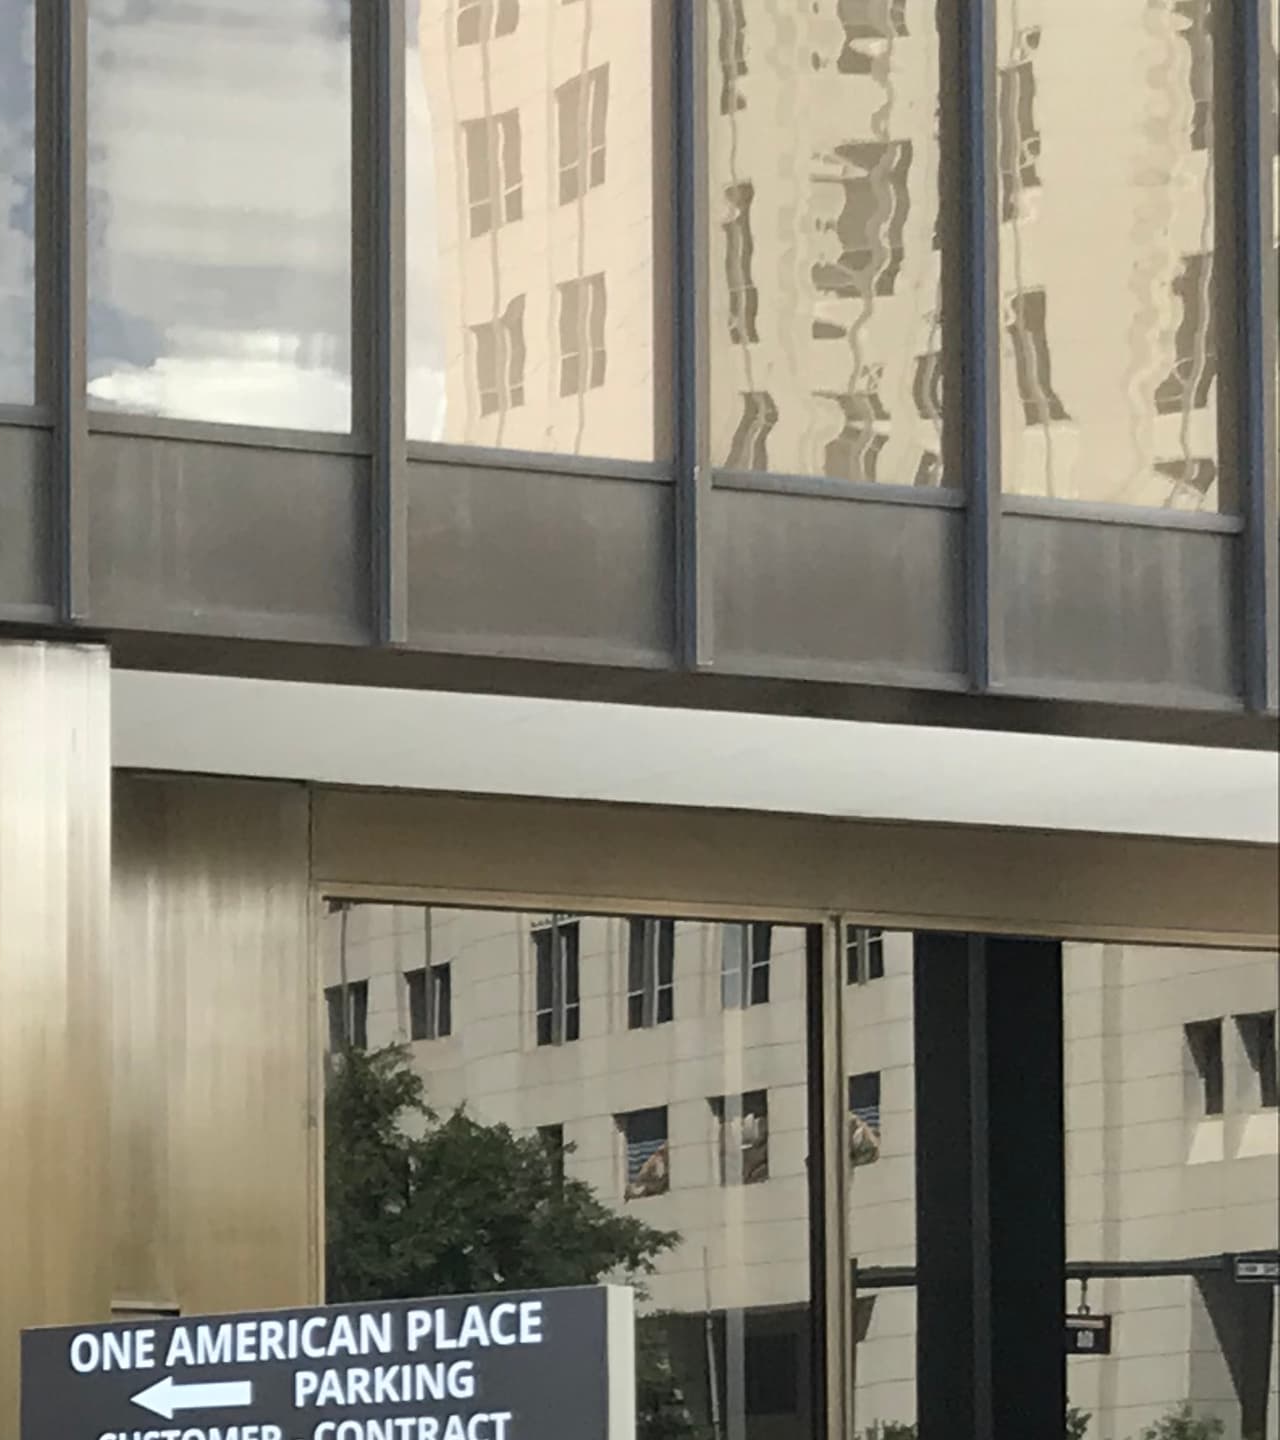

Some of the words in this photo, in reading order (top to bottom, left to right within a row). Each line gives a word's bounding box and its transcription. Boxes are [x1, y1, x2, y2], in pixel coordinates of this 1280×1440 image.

[70, 1329, 156, 1372] ONE
[165, 1311, 392, 1367] AMERICAN
[407, 1301, 543, 1352] PLACE
[294, 1360, 476, 1407] PARKING
